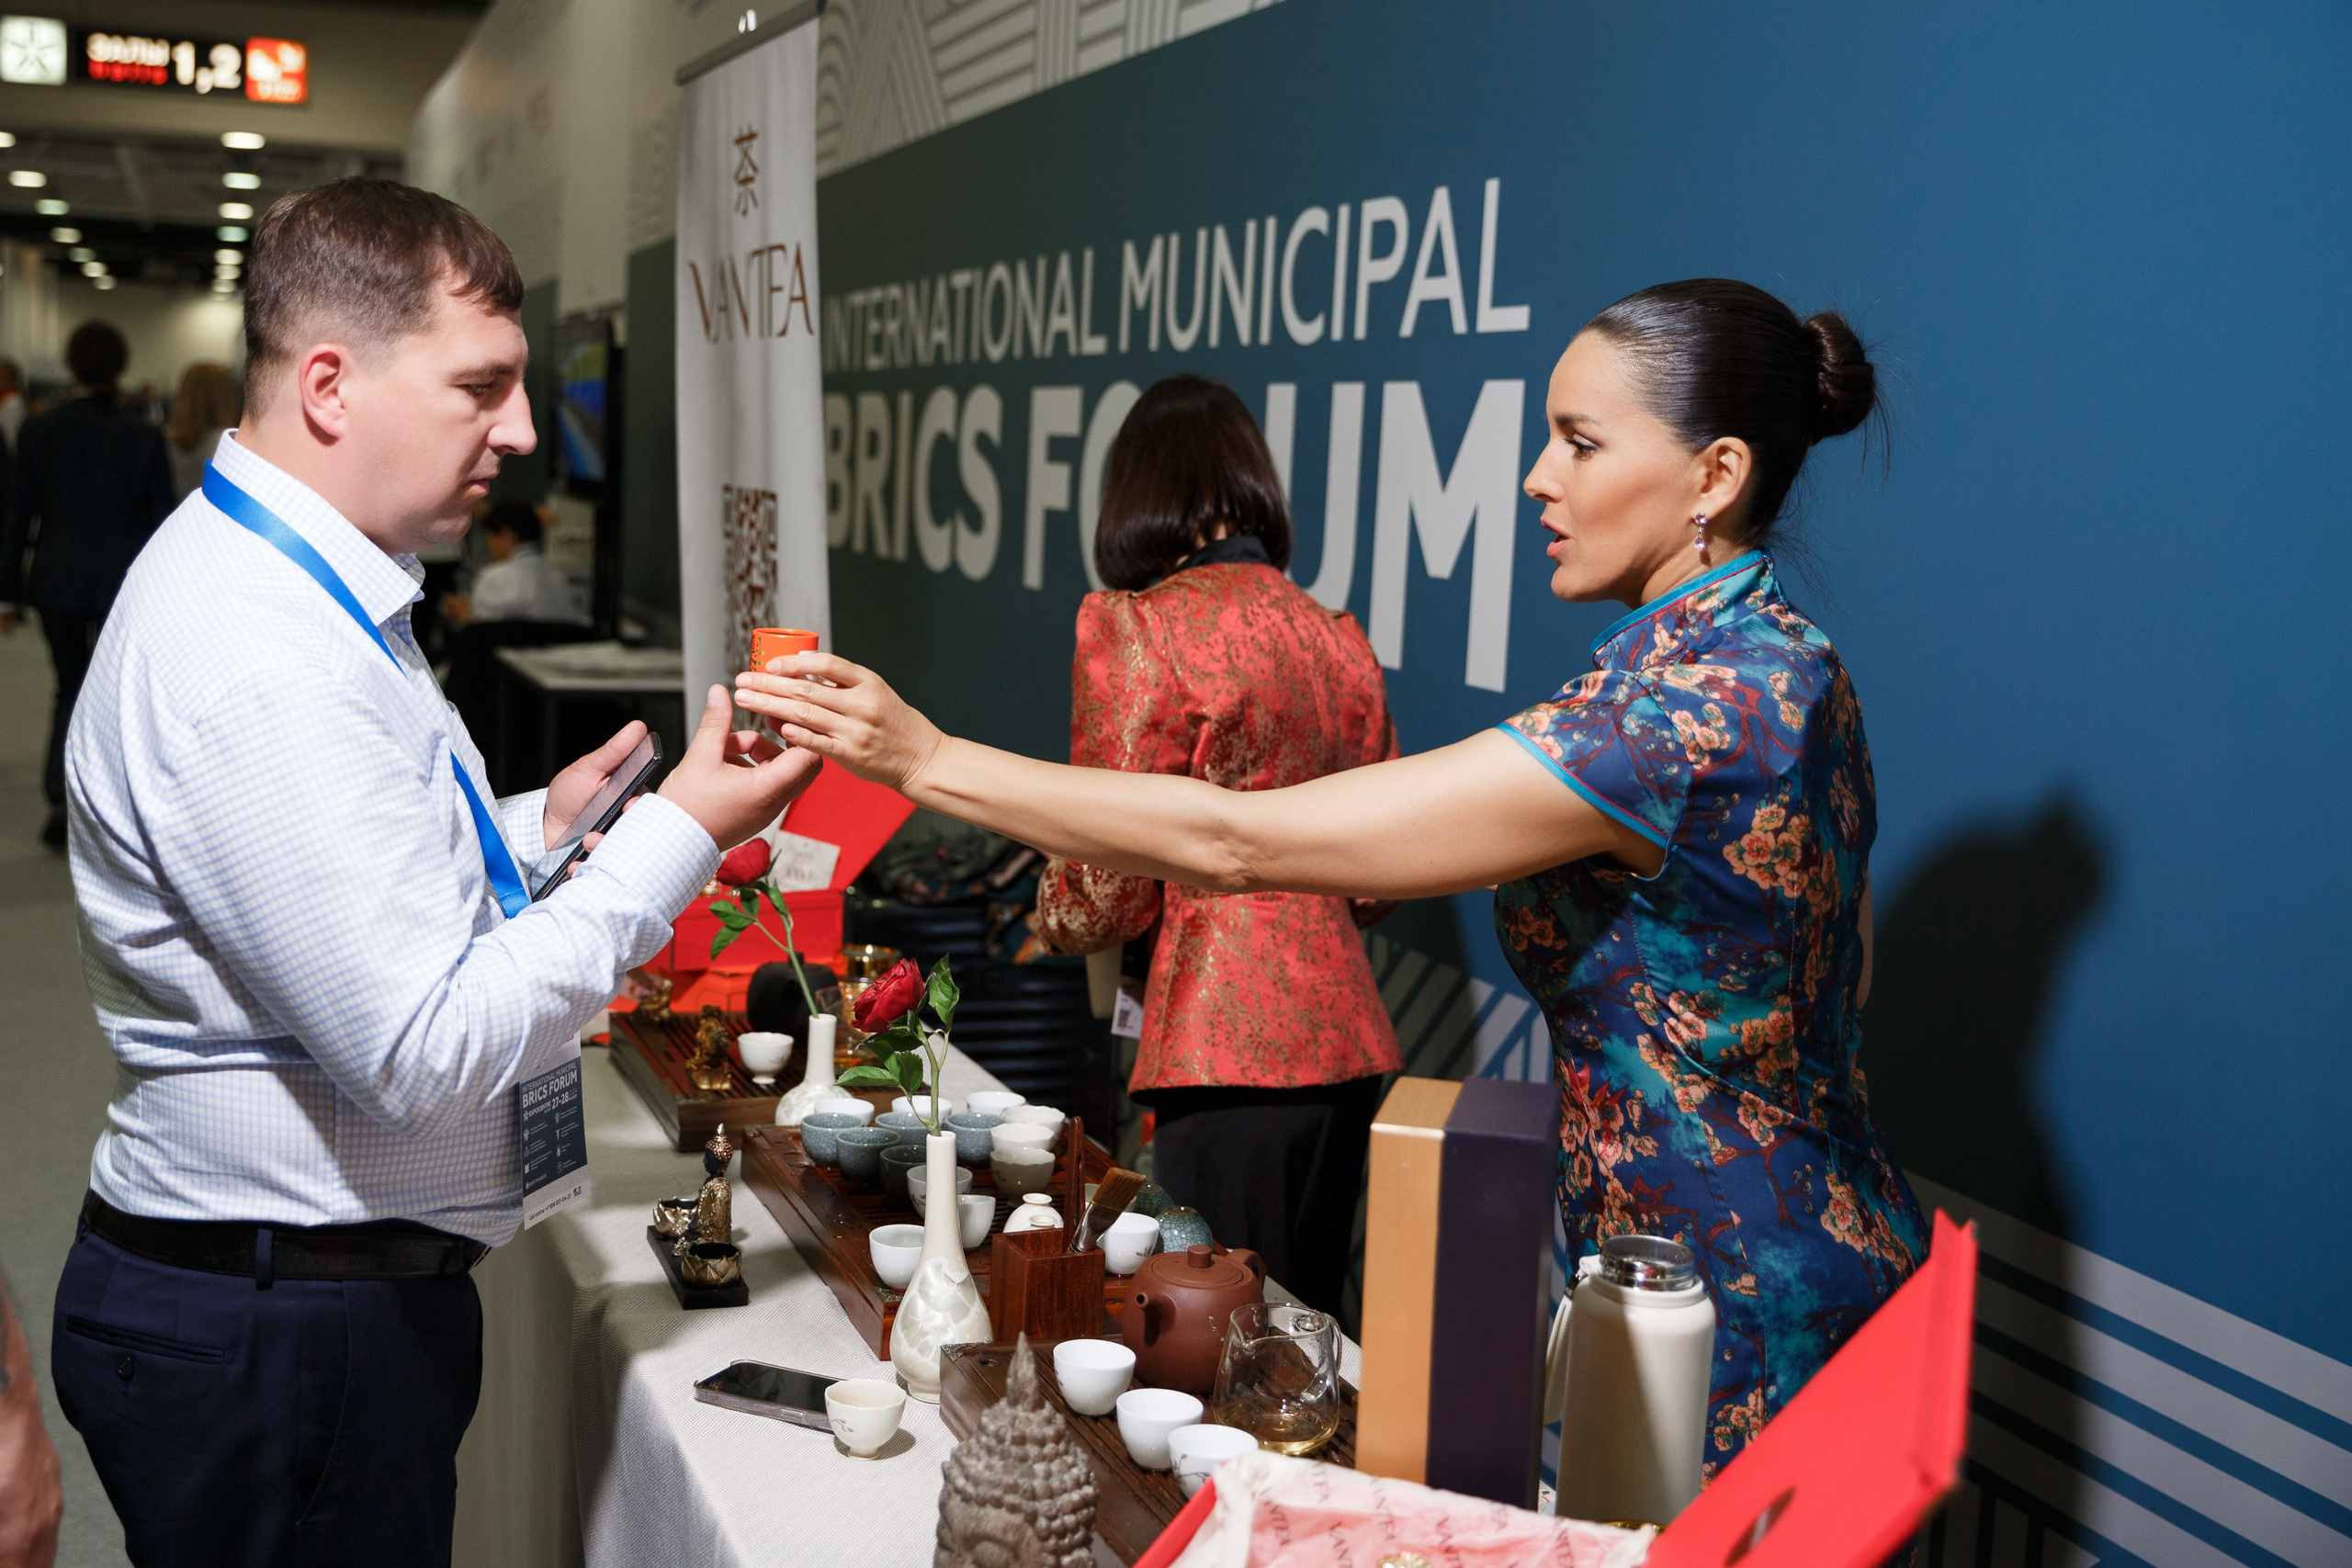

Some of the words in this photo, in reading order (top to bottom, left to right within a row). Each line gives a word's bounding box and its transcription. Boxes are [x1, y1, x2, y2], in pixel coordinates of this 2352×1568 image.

[1118, 178, 1531, 355] MUNICIPAL
[824, 382, 1003, 582] BRICS
[522, 1084, 548, 1109] BRICS
[548, 1068, 577, 1095] FORUM
[551, 1091, 570, 1110] 27-28
